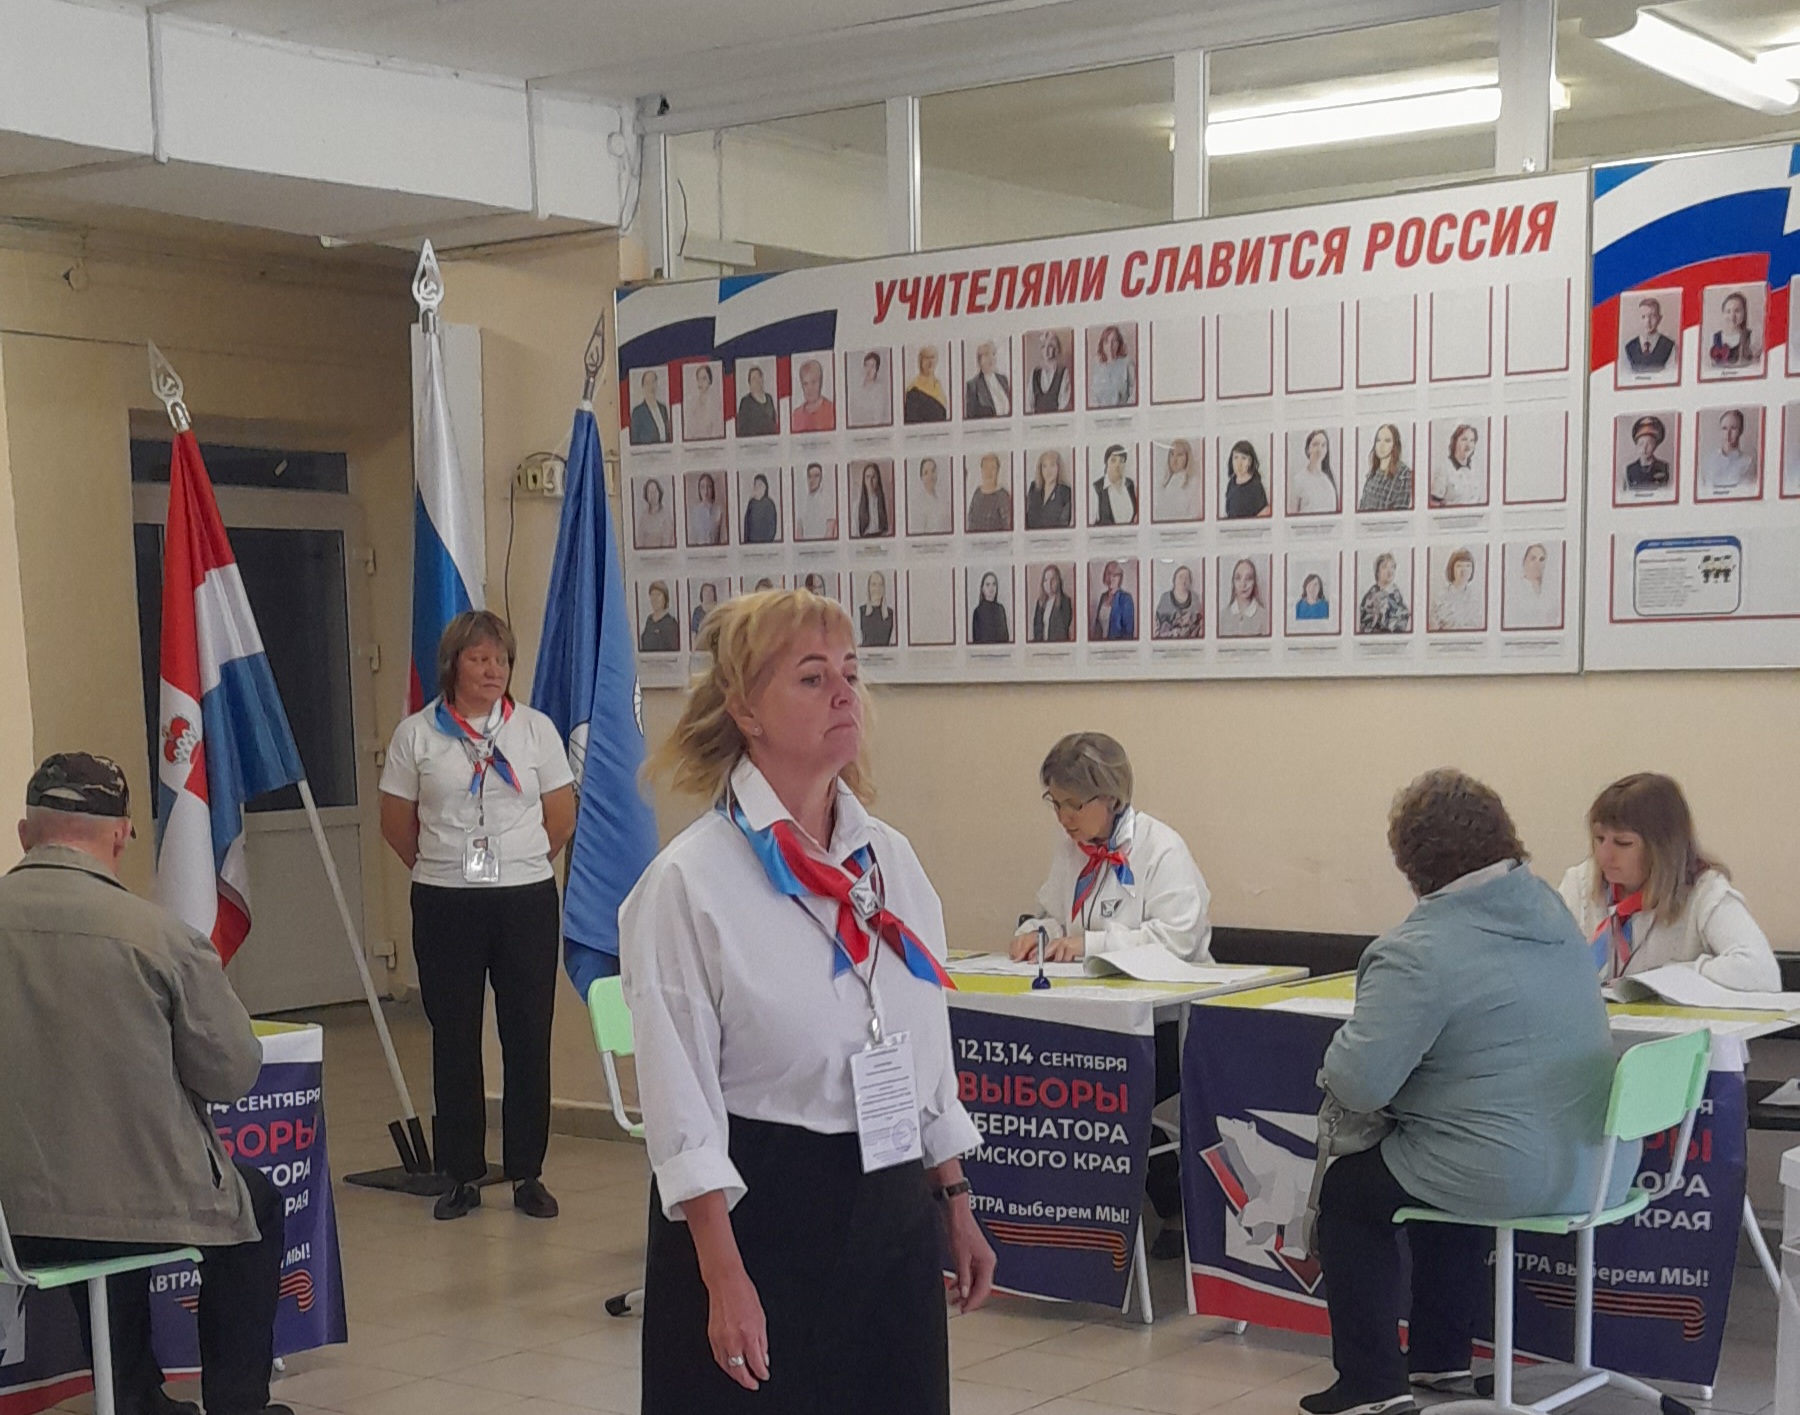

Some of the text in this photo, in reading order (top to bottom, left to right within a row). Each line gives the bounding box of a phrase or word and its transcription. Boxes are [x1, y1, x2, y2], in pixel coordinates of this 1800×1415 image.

[873, 200, 1560, 325] УЧИТЕЛЯМИ СЛАВИТСЯ РОССИЯ
[958, 1038, 1128, 1072] 12,13,14 СЕНТЯБРЯ
[236, 1087, 321, 1112] СЕНТЯБРЯ
[957, 1071, 1129, 1114] ВЫБОРЫ
[215, 1114, 318, 1159] БОРЫ
[969, 1112, 1130, 1145] БЕРНАТОРА
[958, 1145, 1131, 1175] РМСКОГО КРАЯ
[285, 1189, 309, 1217] РАЯ
[1008, 1201, 1092, 1221] выберем
[1095, 1205, 1130, 1224] МЫ!
[1634, 1208, 1711, 1231] КРАЯ
[1660, 1267, 1710, 1287] МЫ!
